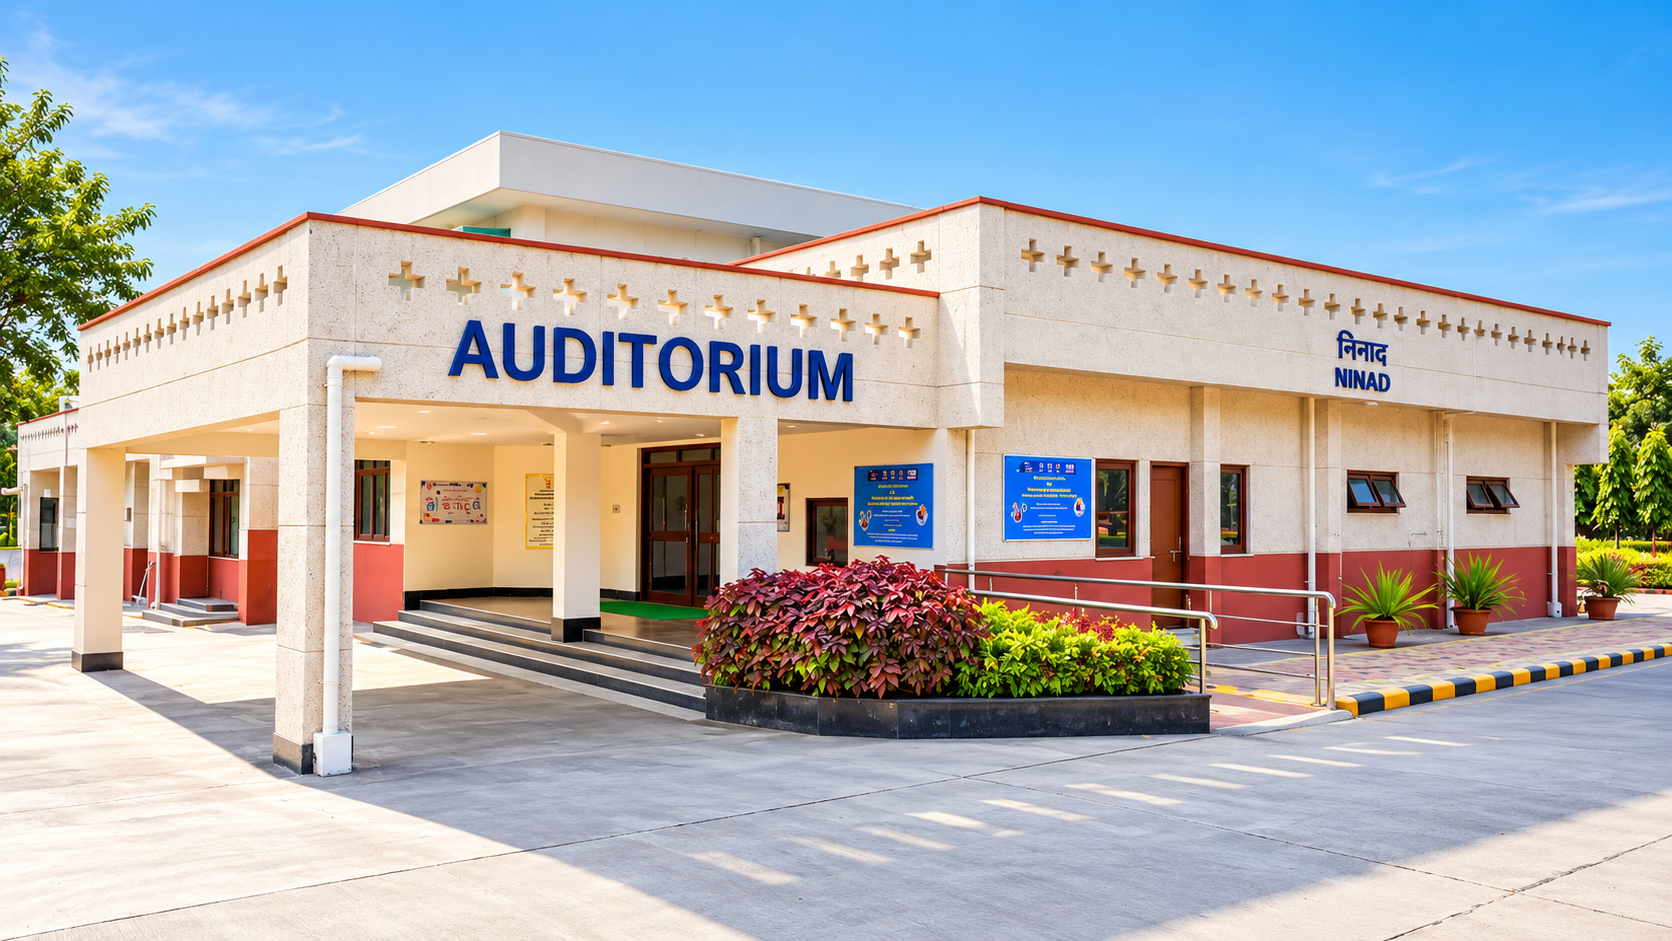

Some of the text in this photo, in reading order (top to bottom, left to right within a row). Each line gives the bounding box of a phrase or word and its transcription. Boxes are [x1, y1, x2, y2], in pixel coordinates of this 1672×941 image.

[449, 320, 853, 401] AUDITORIUM
[1336, 329, 1389, 366] निनाद
[1334, 366, 1391, 392] NINAD
